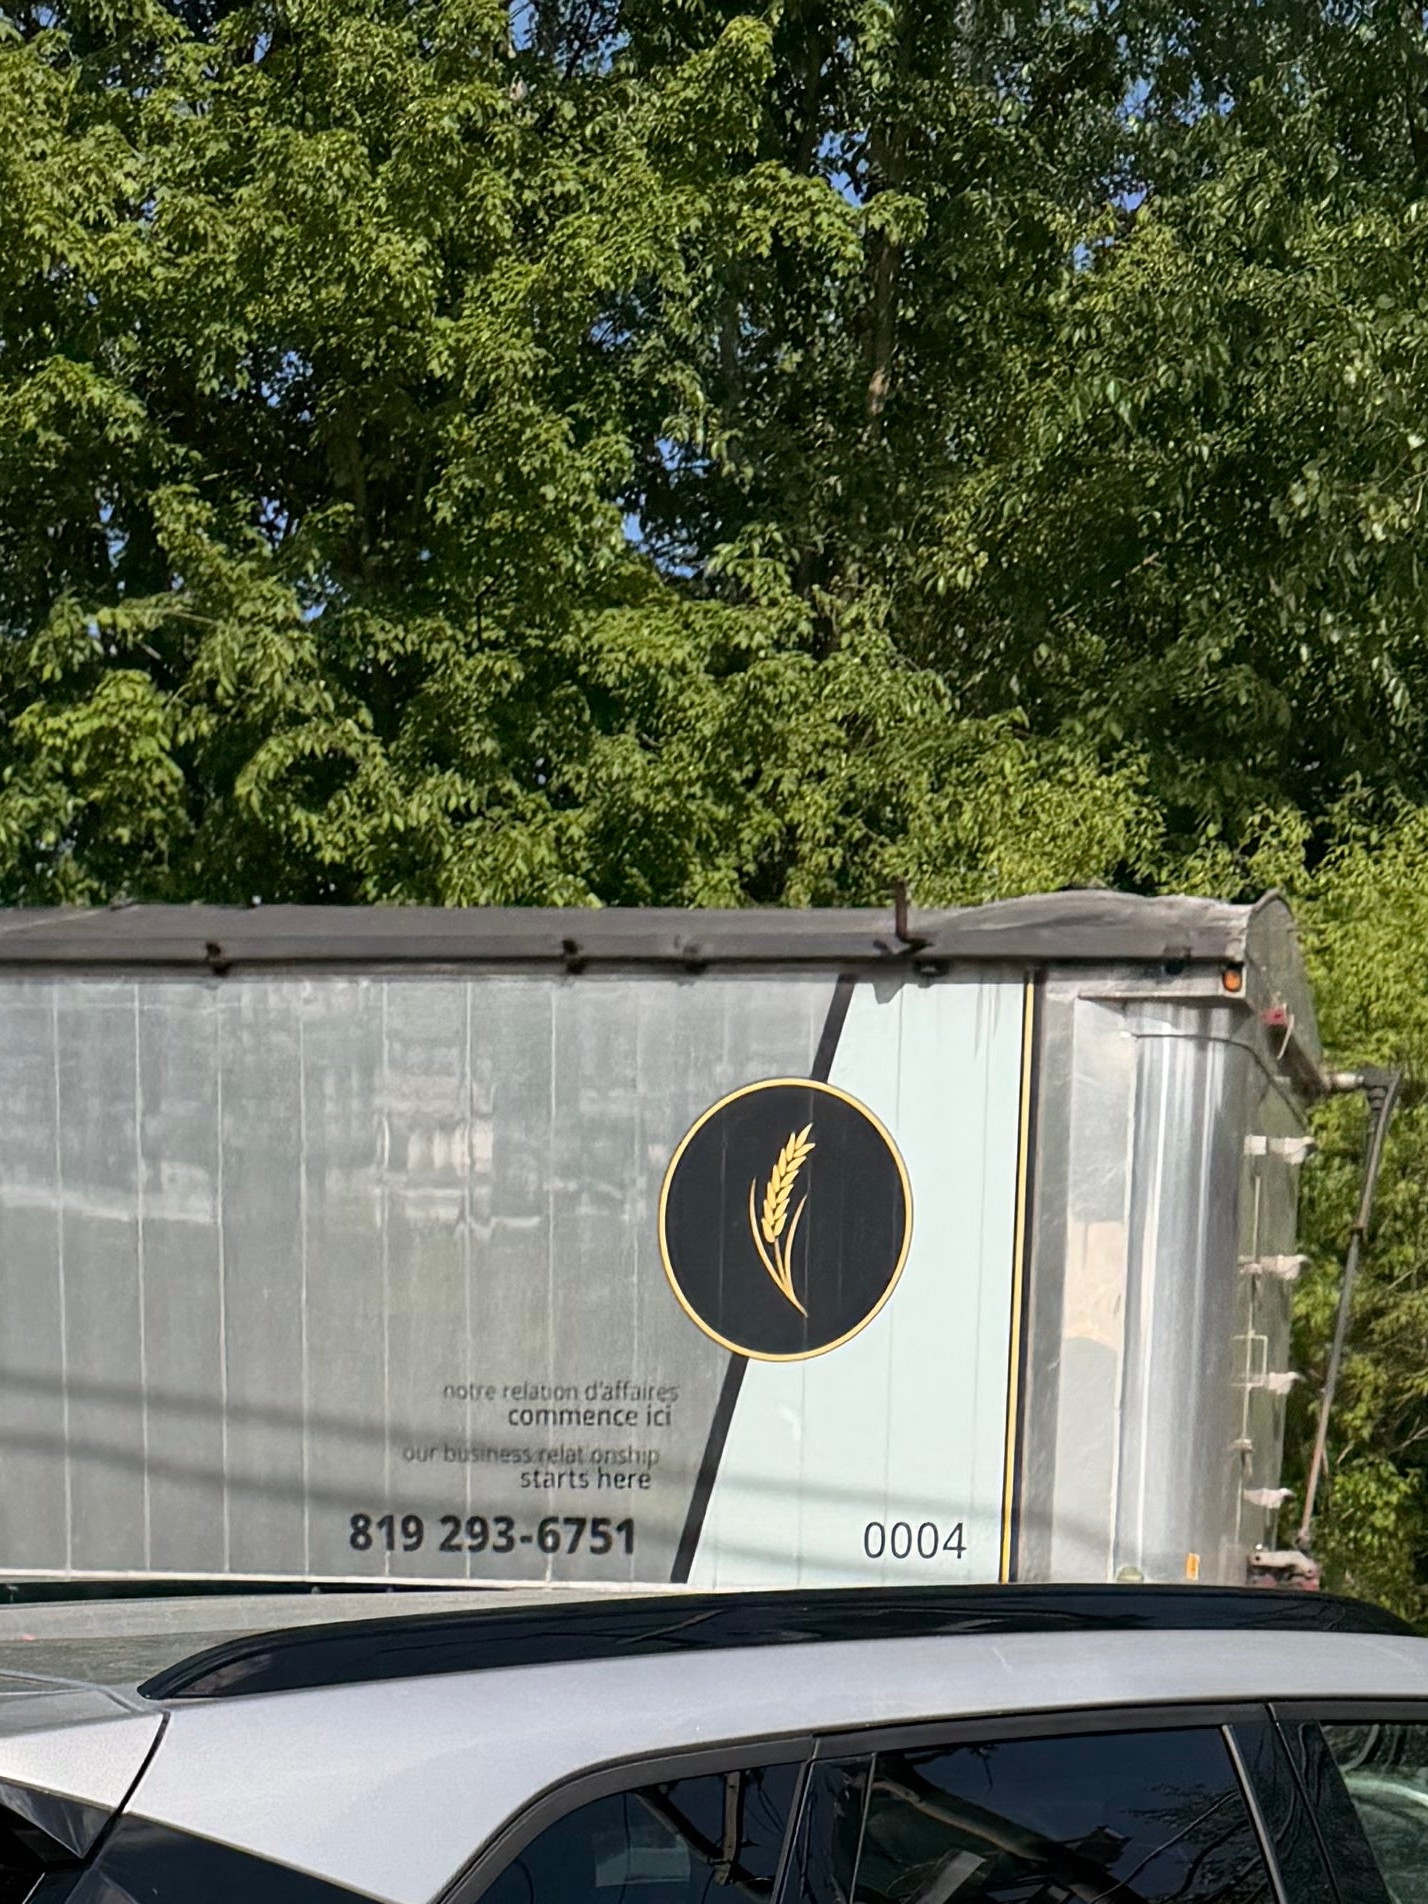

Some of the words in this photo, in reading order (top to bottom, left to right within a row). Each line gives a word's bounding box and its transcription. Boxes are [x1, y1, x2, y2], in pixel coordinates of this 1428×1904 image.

[442, 1383, 497, 1401] notre
[502, 1381, 579, 1401] relation
[584, 1380, 680, 1403] d'affaires
[507, 1407, 639, 1427] commence
[646, 1403, 673, 1427] ici
[402, 1448, 436, 1463] our
[443, 1445, 533, 1464] business
[536, 1446, 661, 1470] relatonship
[520, 1469, 590, 1490] starts
[597, 1467, 652, 1490] here
[349, 1513, 425, 1552] 819
[438, 1514, 636, 1556] 293-6751
[863, 1521, 967, 1560] 0004
